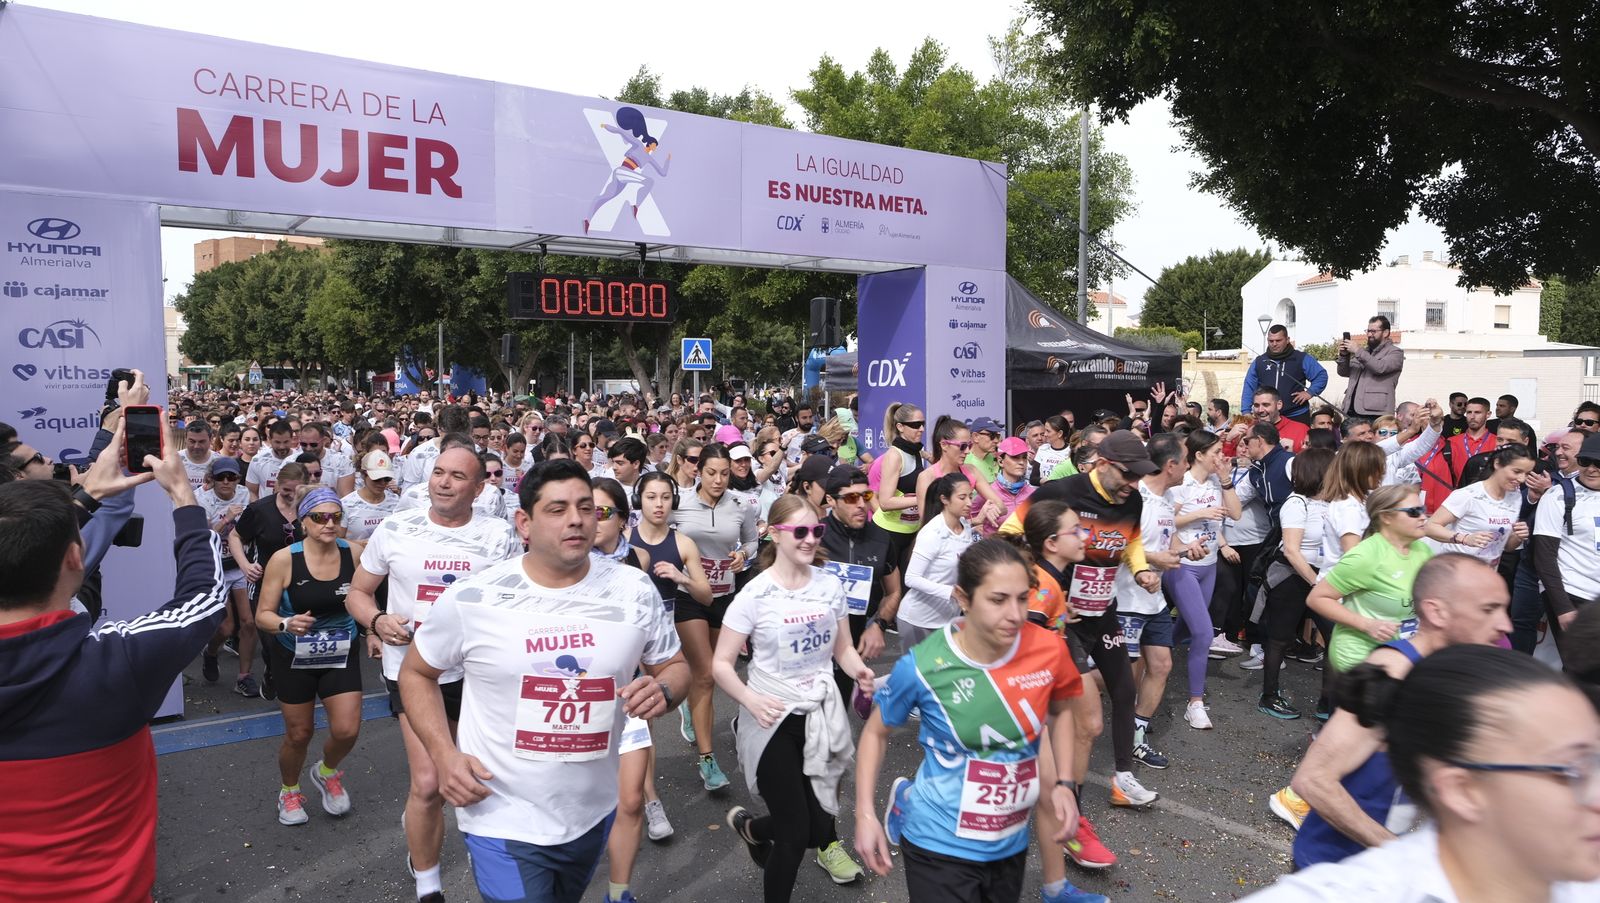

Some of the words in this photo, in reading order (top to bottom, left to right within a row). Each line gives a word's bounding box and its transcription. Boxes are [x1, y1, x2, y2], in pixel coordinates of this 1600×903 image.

[194, 68, 352, 115] CARRERA
[363, 91, 401, 120] DE
[412, 98, 447, 127] LA
[176, 107, 463, 199] MUJER
[796, 153, 818, 174] LA
[822, 157, 905, 185] IGUALDAD
[768, 180, 792, 201] ES
[795, 183, 876, 210] NUESTRA
[879, 194, 928, 216] META.
[776, 213, 806, 232] CDX
[7, 241, 102, 257] HYUNDAI
[20, 256, 92, 269] Almerialva
[33, 284, 110, 300] cajamar
[540, 278, 668, 318] 00:00:00
[951, 296, 986, 305] HYUNDAI
[959, 321, 988, 330] cajamar
[18, 327, 85, 349] CASI
[953, 346, 978, 360] CASI
[43, 365, 110, 380] vithas
[867, 352, 912, 387] CDX
[961, 368, 986, 378] vithas
[956, 398, 985, 409] aqualia
[34, 412, 101, 433] aquali
[424, 560, 471, 571] MUJER
[1079, 581, 1112, 595] 2556
[528, 626, 565, 636] CARRERA
[566, 624, 578, 632] DE
[579, 623, 589, 631] LA
[308, 640, 338, 654] 334
[525, 632, 596, 654] MUJER
[790, 629, 832, 654] 1206
[542, 701, 591, 725] 701
[975, 780, 1031, 806] 2517
